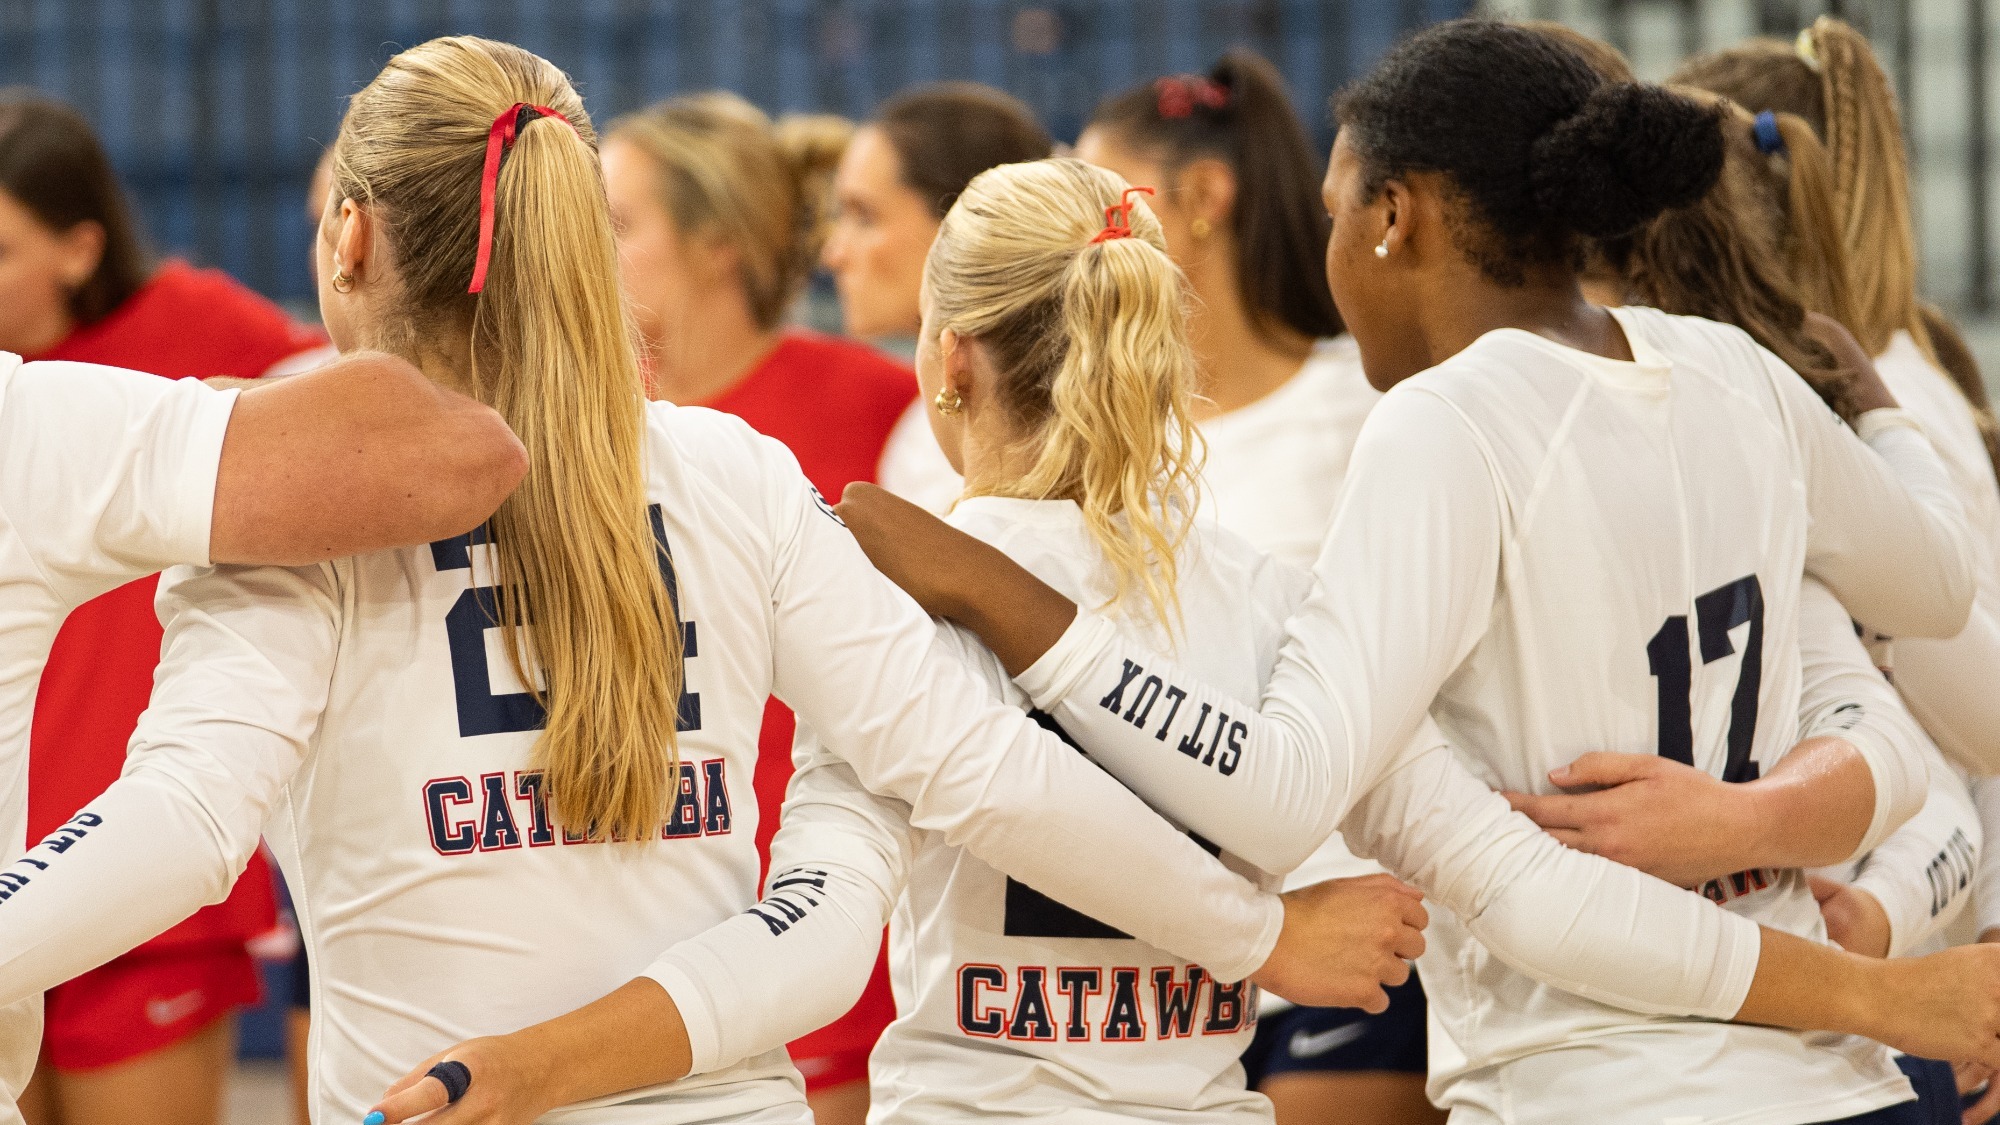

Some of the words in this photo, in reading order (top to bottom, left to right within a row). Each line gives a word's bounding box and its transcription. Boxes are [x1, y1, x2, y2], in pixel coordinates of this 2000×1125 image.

[1099, 658, 1188, 743] LUX
[1647, 574, 1764, 784] 17
[1178, 702, 1248, 777] SIT
[422, 757, 732, 857] CATBA
